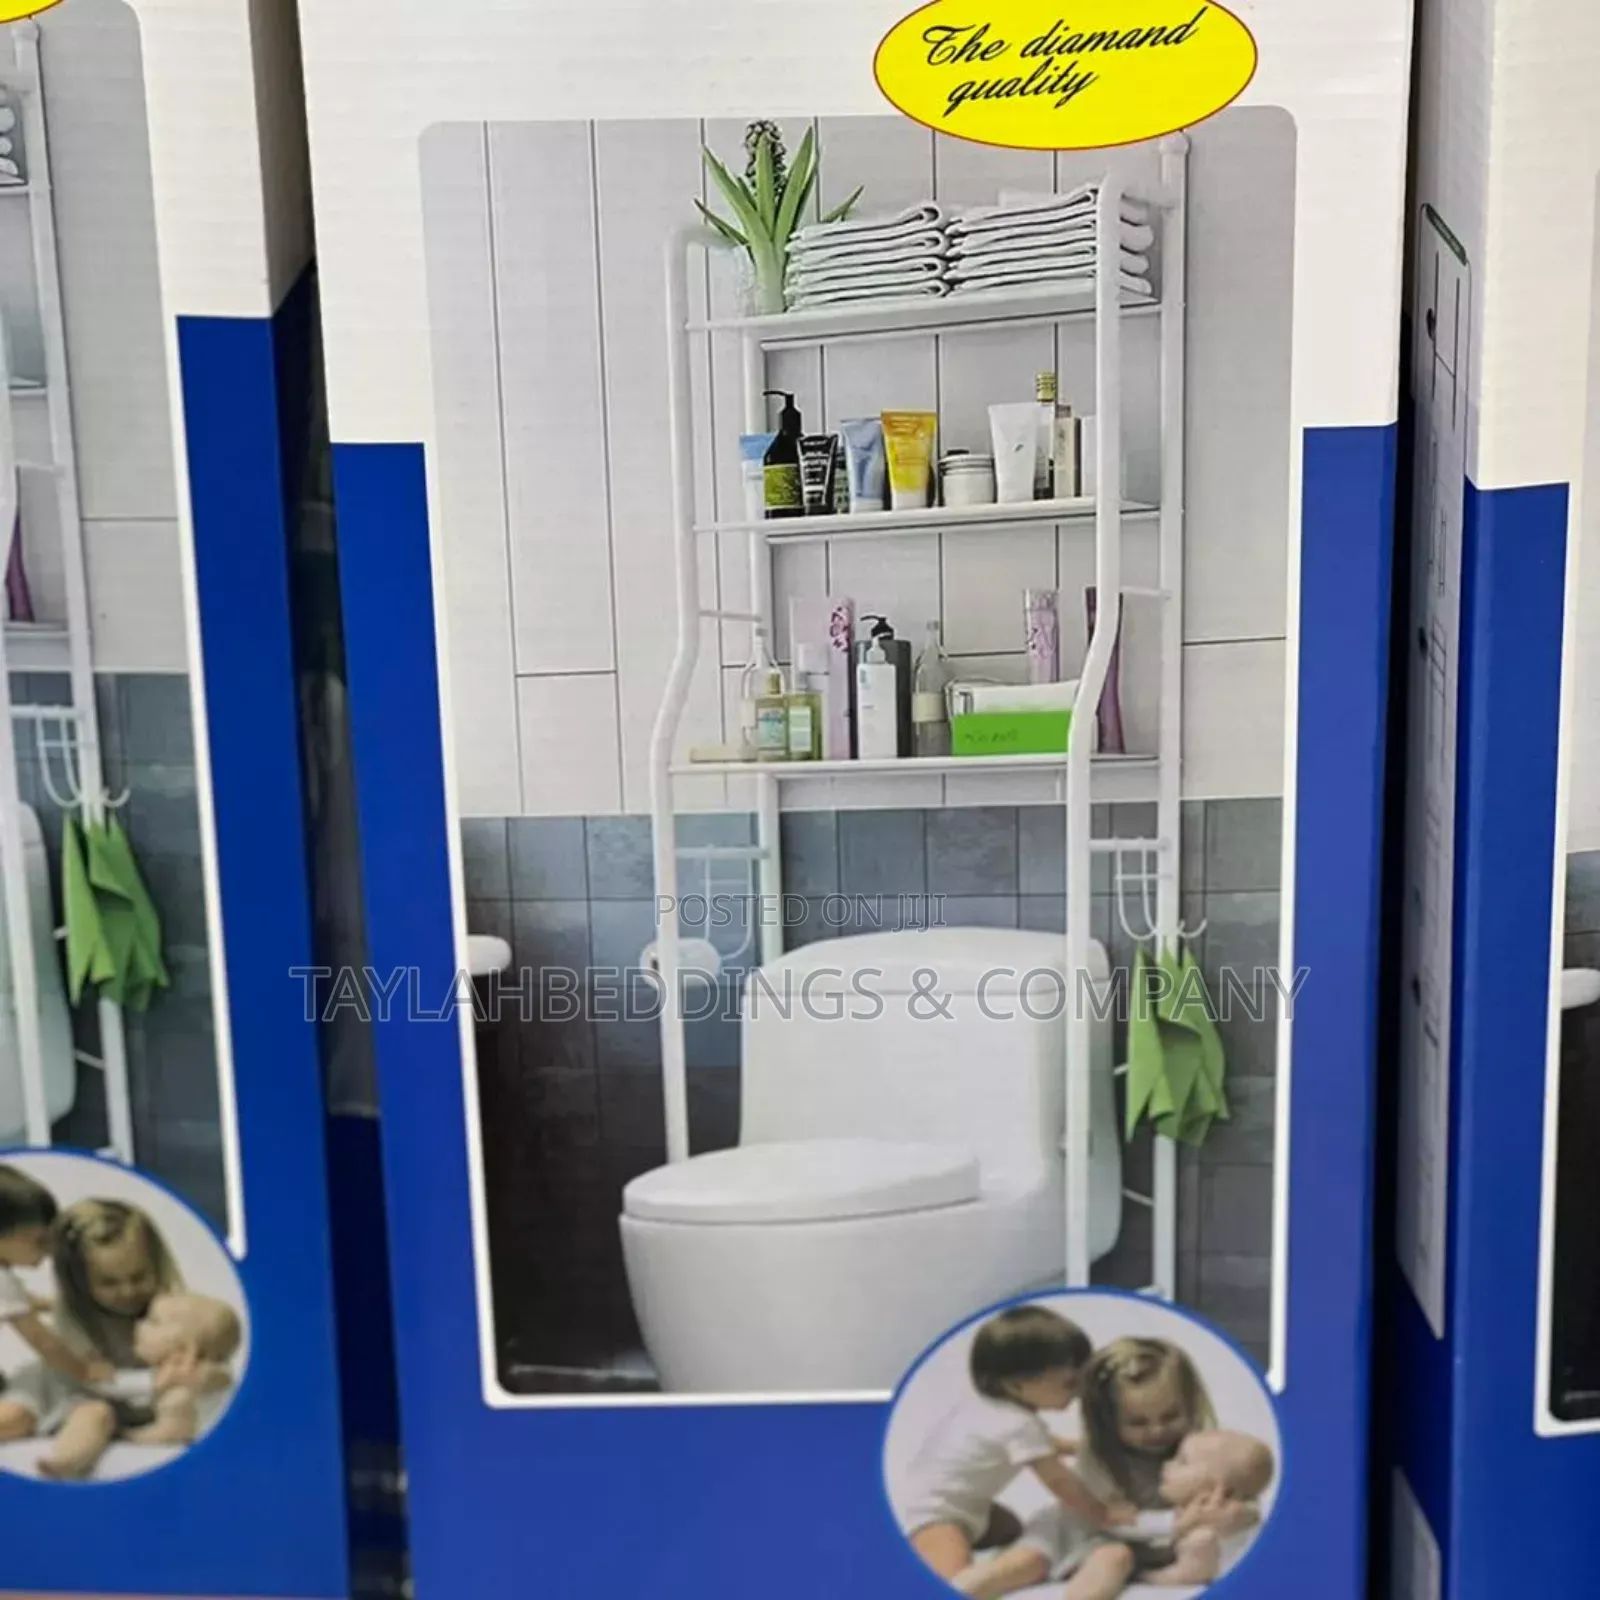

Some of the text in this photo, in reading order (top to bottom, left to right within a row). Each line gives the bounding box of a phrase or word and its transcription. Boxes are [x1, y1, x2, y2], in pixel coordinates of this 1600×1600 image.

[922, 6, 1209, 66] The diamand
[942, 57, 1098, 118] quality
